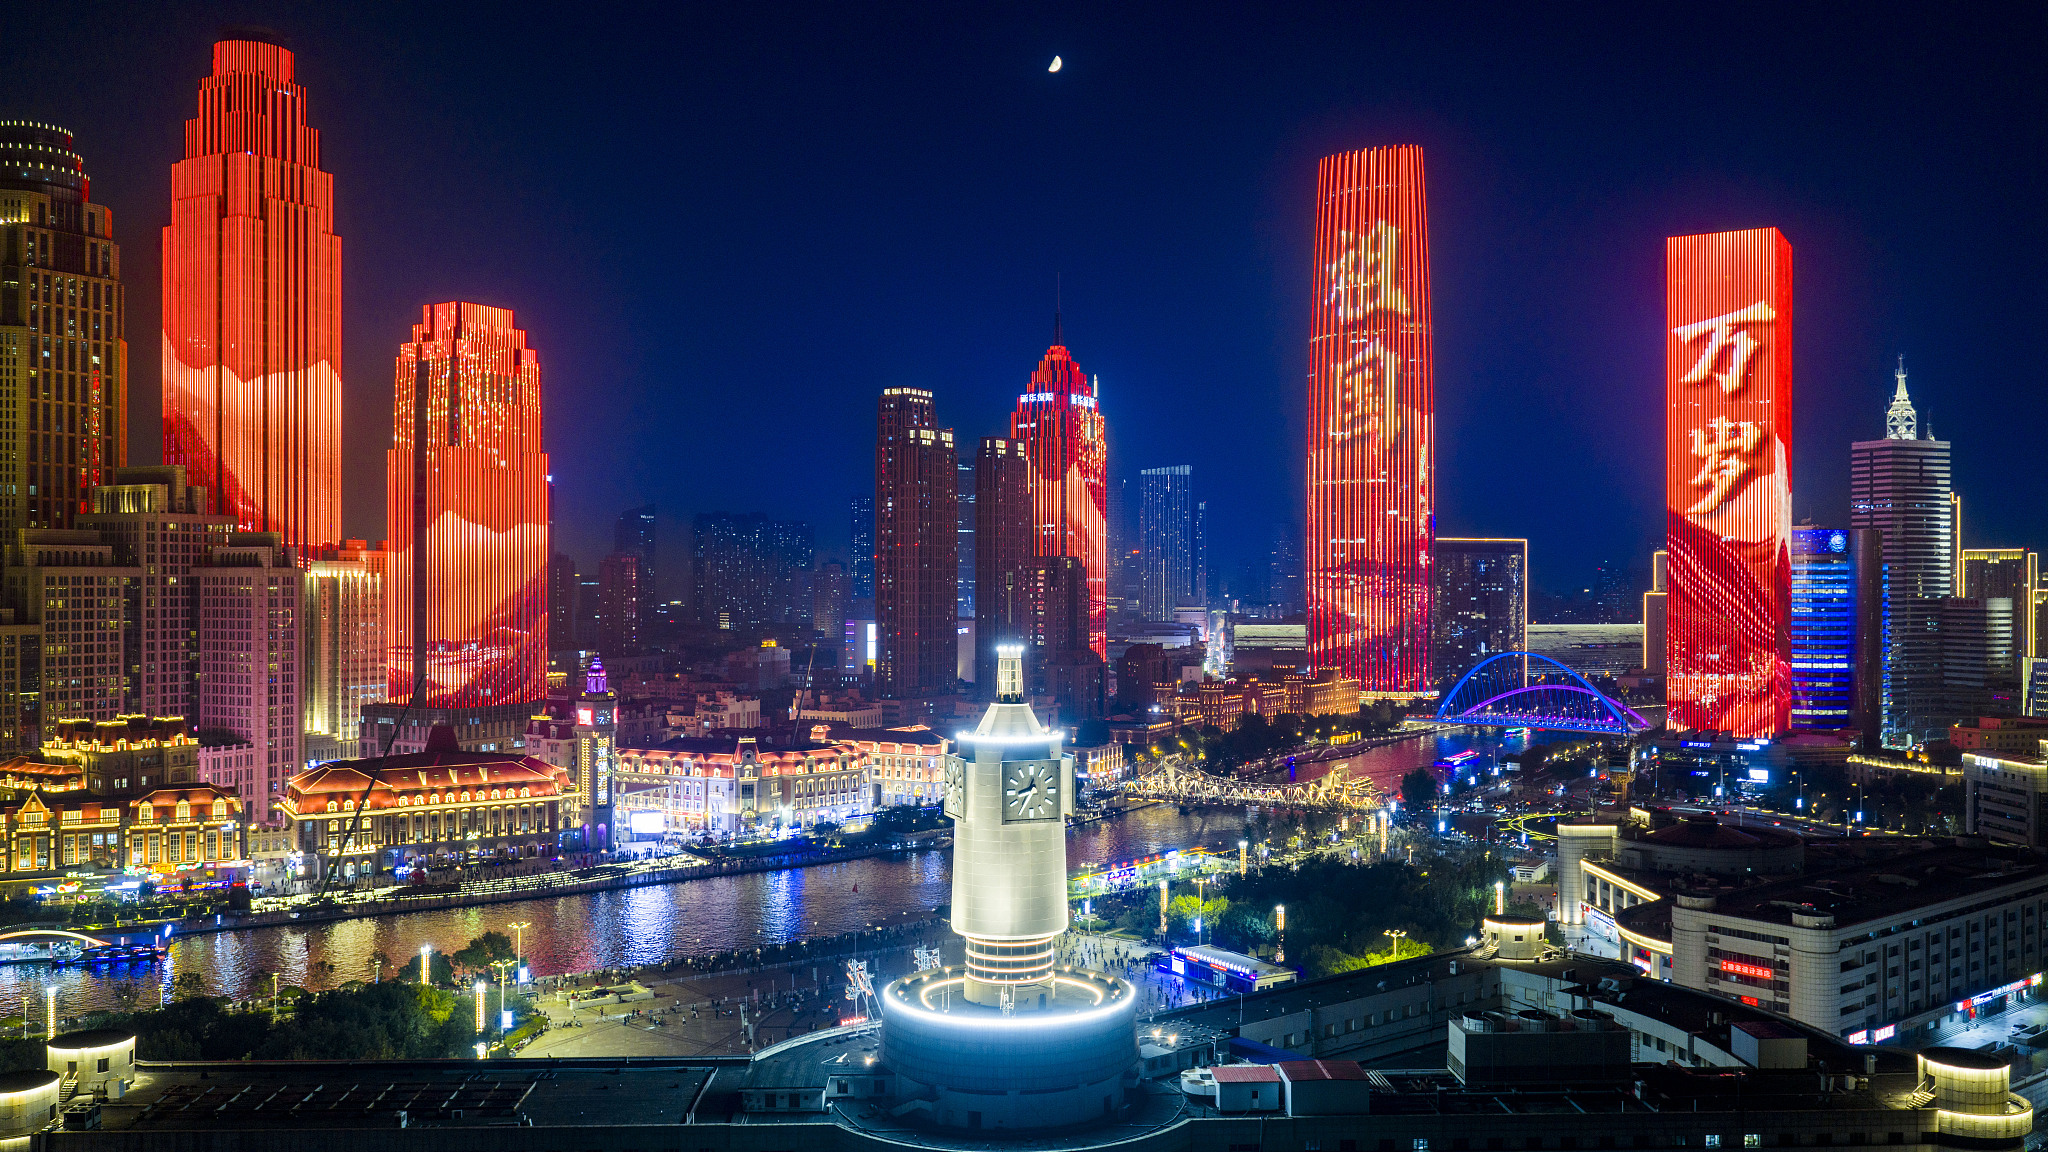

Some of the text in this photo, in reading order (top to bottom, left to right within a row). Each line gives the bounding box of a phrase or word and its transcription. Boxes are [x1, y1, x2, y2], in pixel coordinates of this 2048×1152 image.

[1020, 392, 1054, 403] 新华保险
[1671, 299, 1776, 519] 万岁
